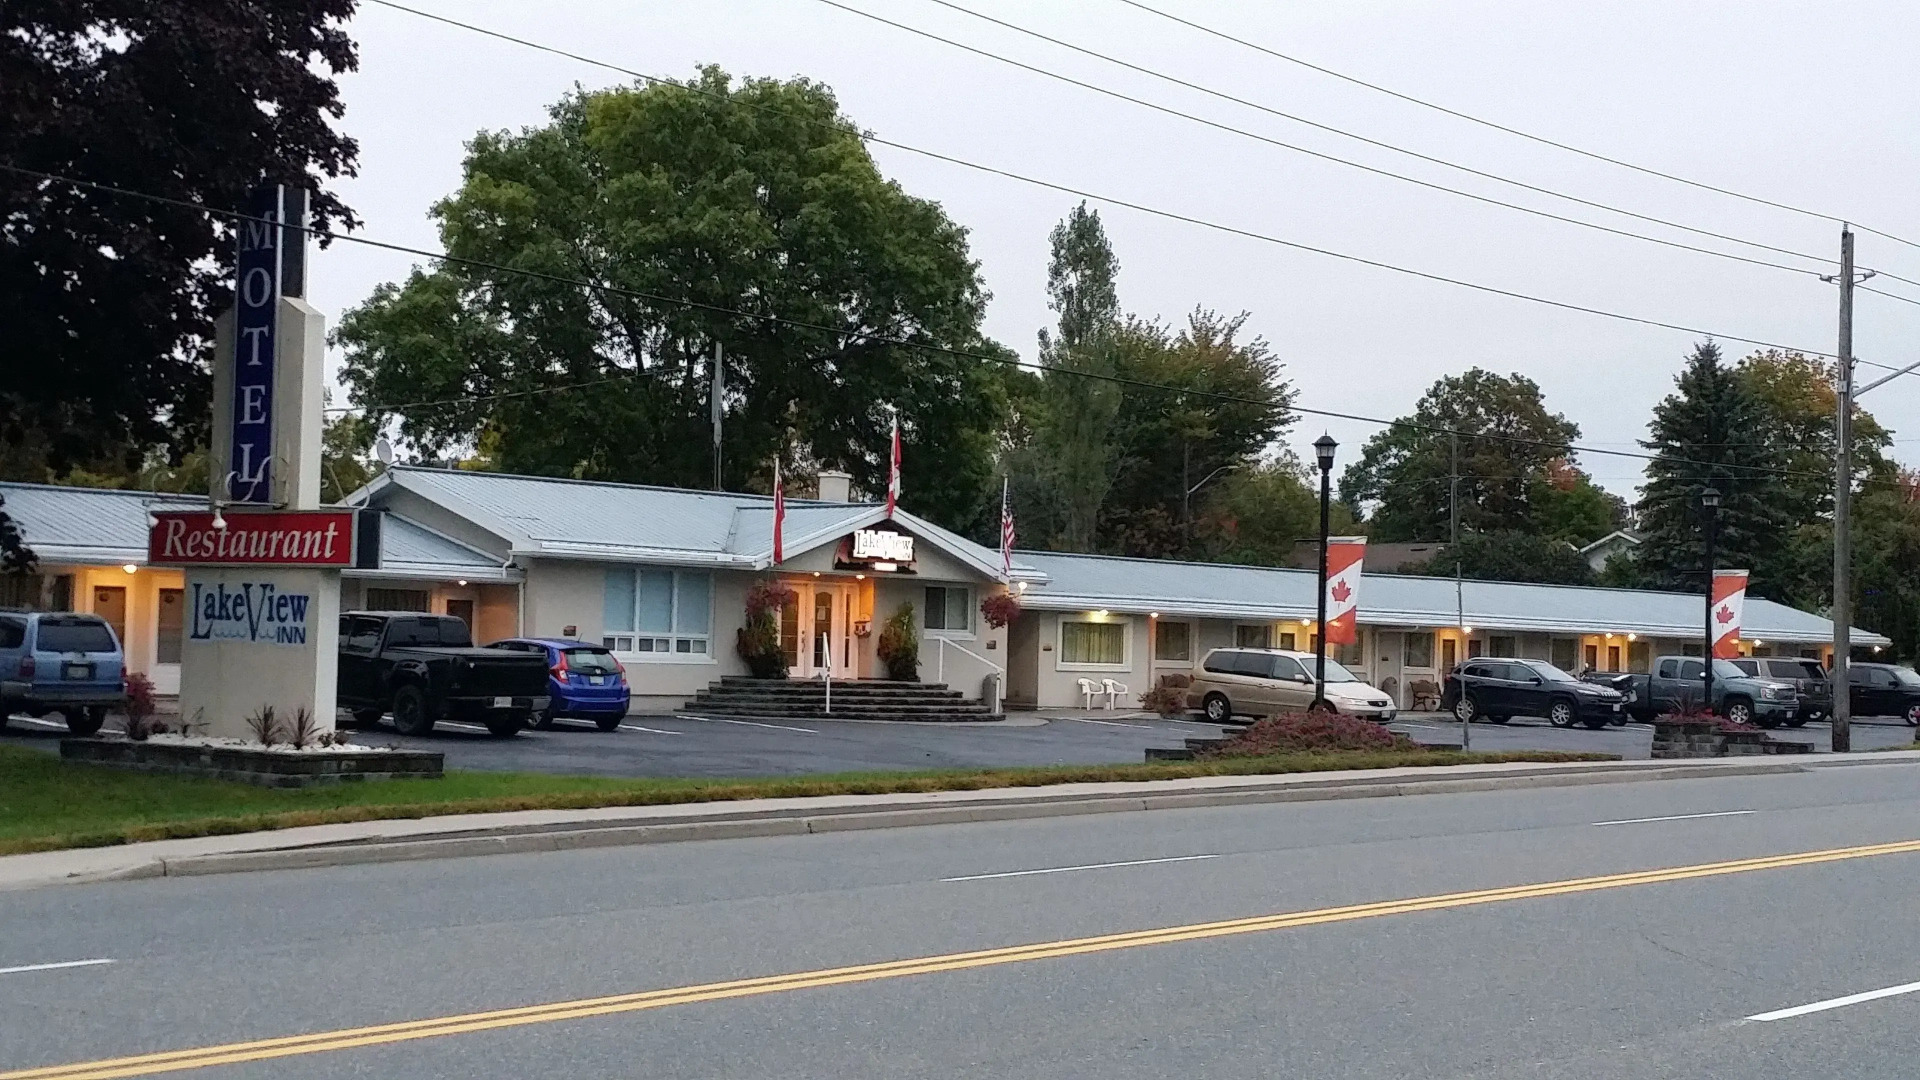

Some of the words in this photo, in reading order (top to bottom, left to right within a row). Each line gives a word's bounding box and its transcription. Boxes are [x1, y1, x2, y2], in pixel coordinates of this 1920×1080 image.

[240, 211, 274, 482] MOTEL
[162, 519, 338, 559] Restaurant
[276, 626, 306, 644] INN
